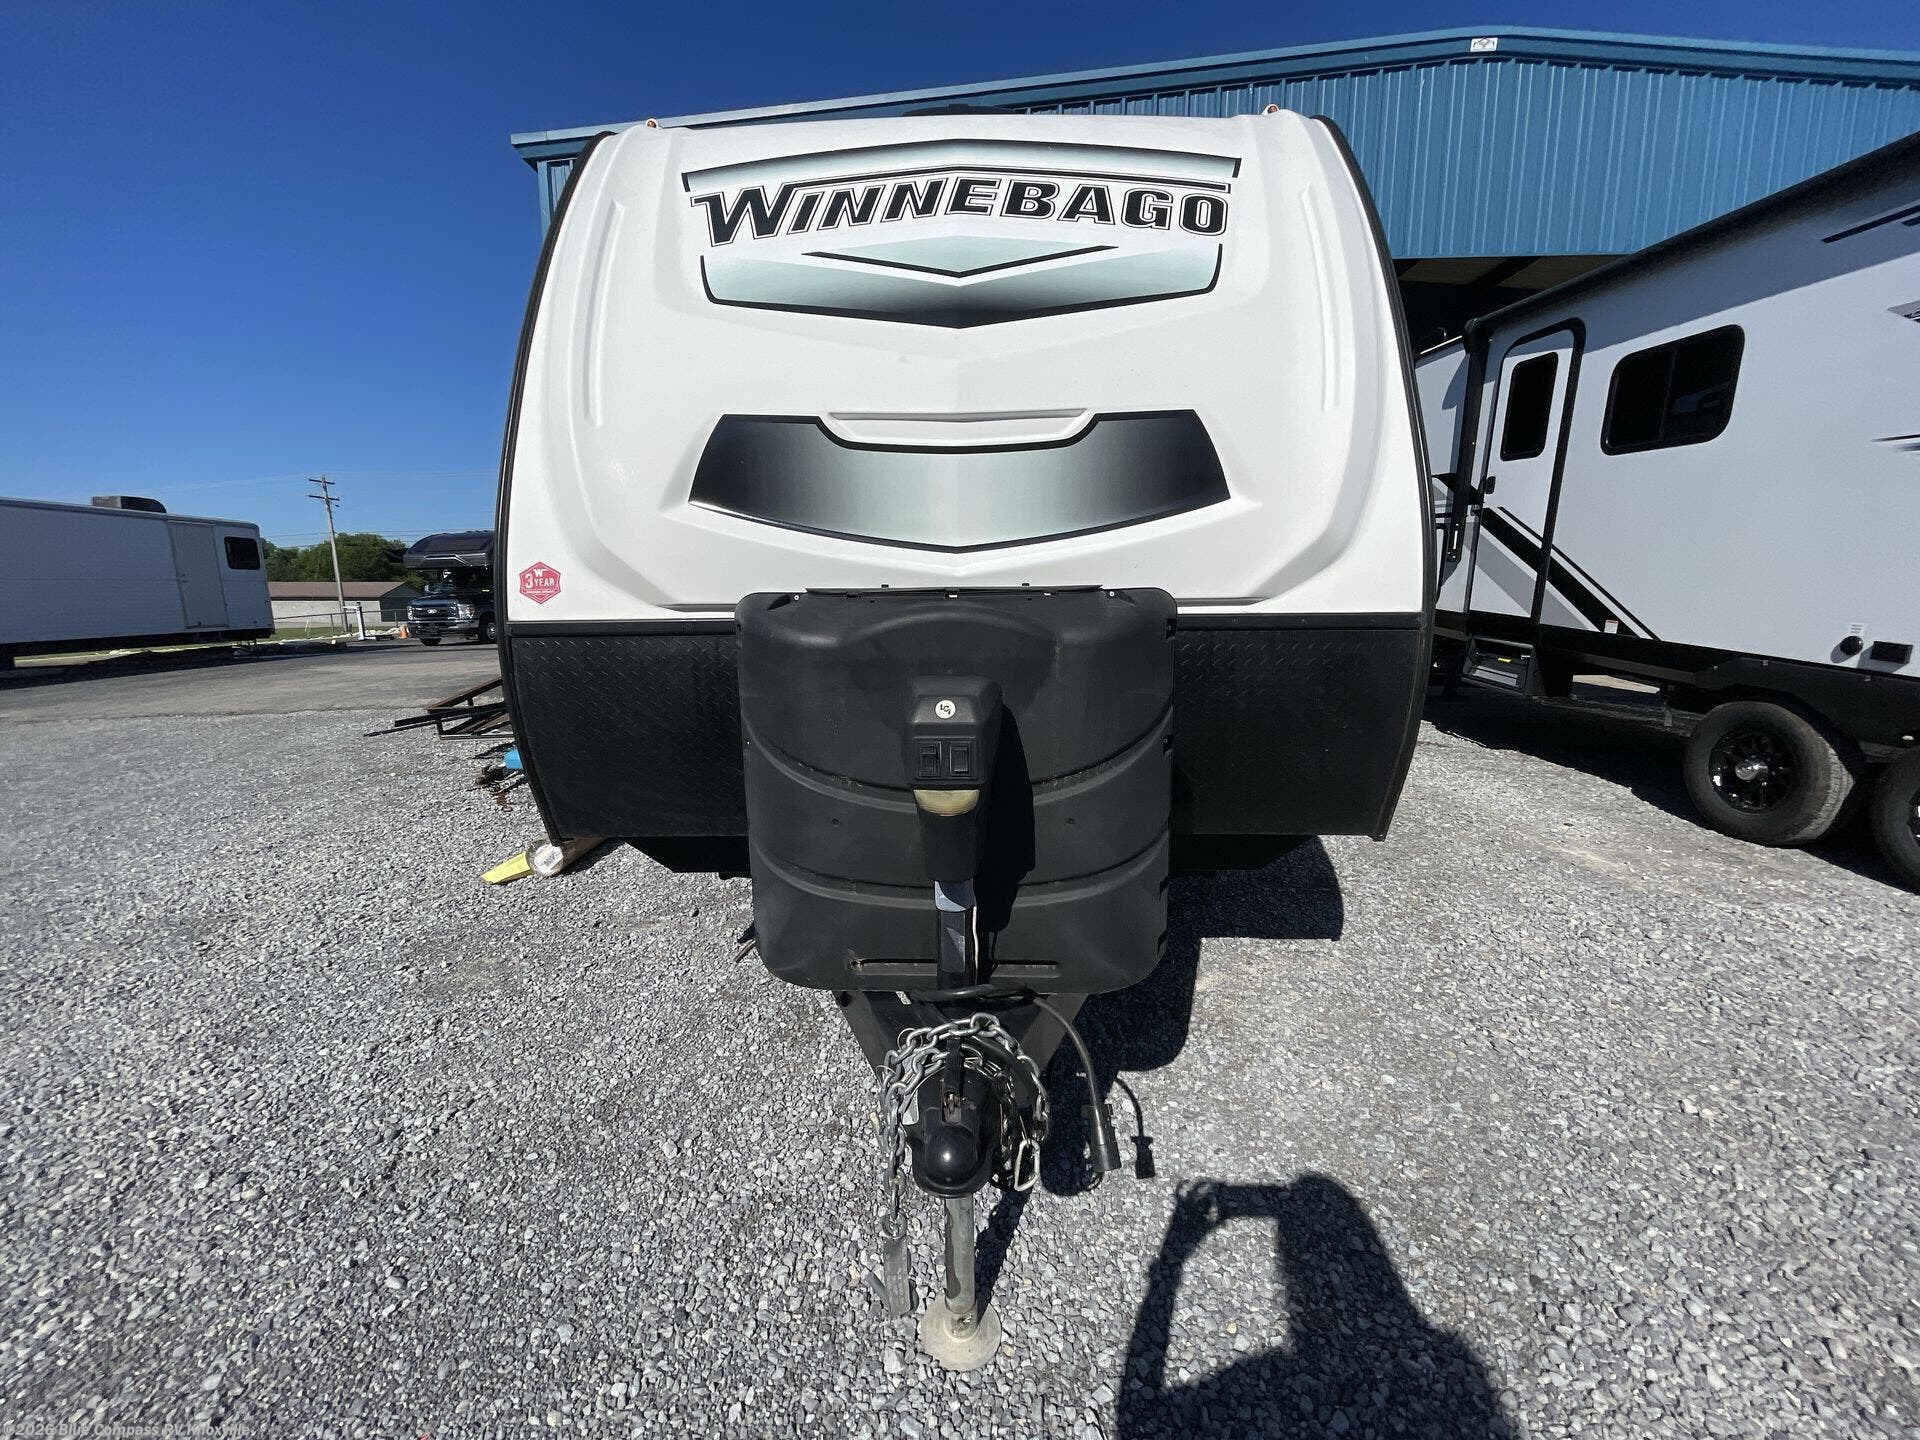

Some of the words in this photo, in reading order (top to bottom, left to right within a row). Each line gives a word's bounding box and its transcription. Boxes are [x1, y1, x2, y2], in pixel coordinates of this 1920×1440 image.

[690, 176, 1229, 247] WINNEBAGO
[524, 573, 533, 589] 3
[534, 578, 555, 587] YEAR
